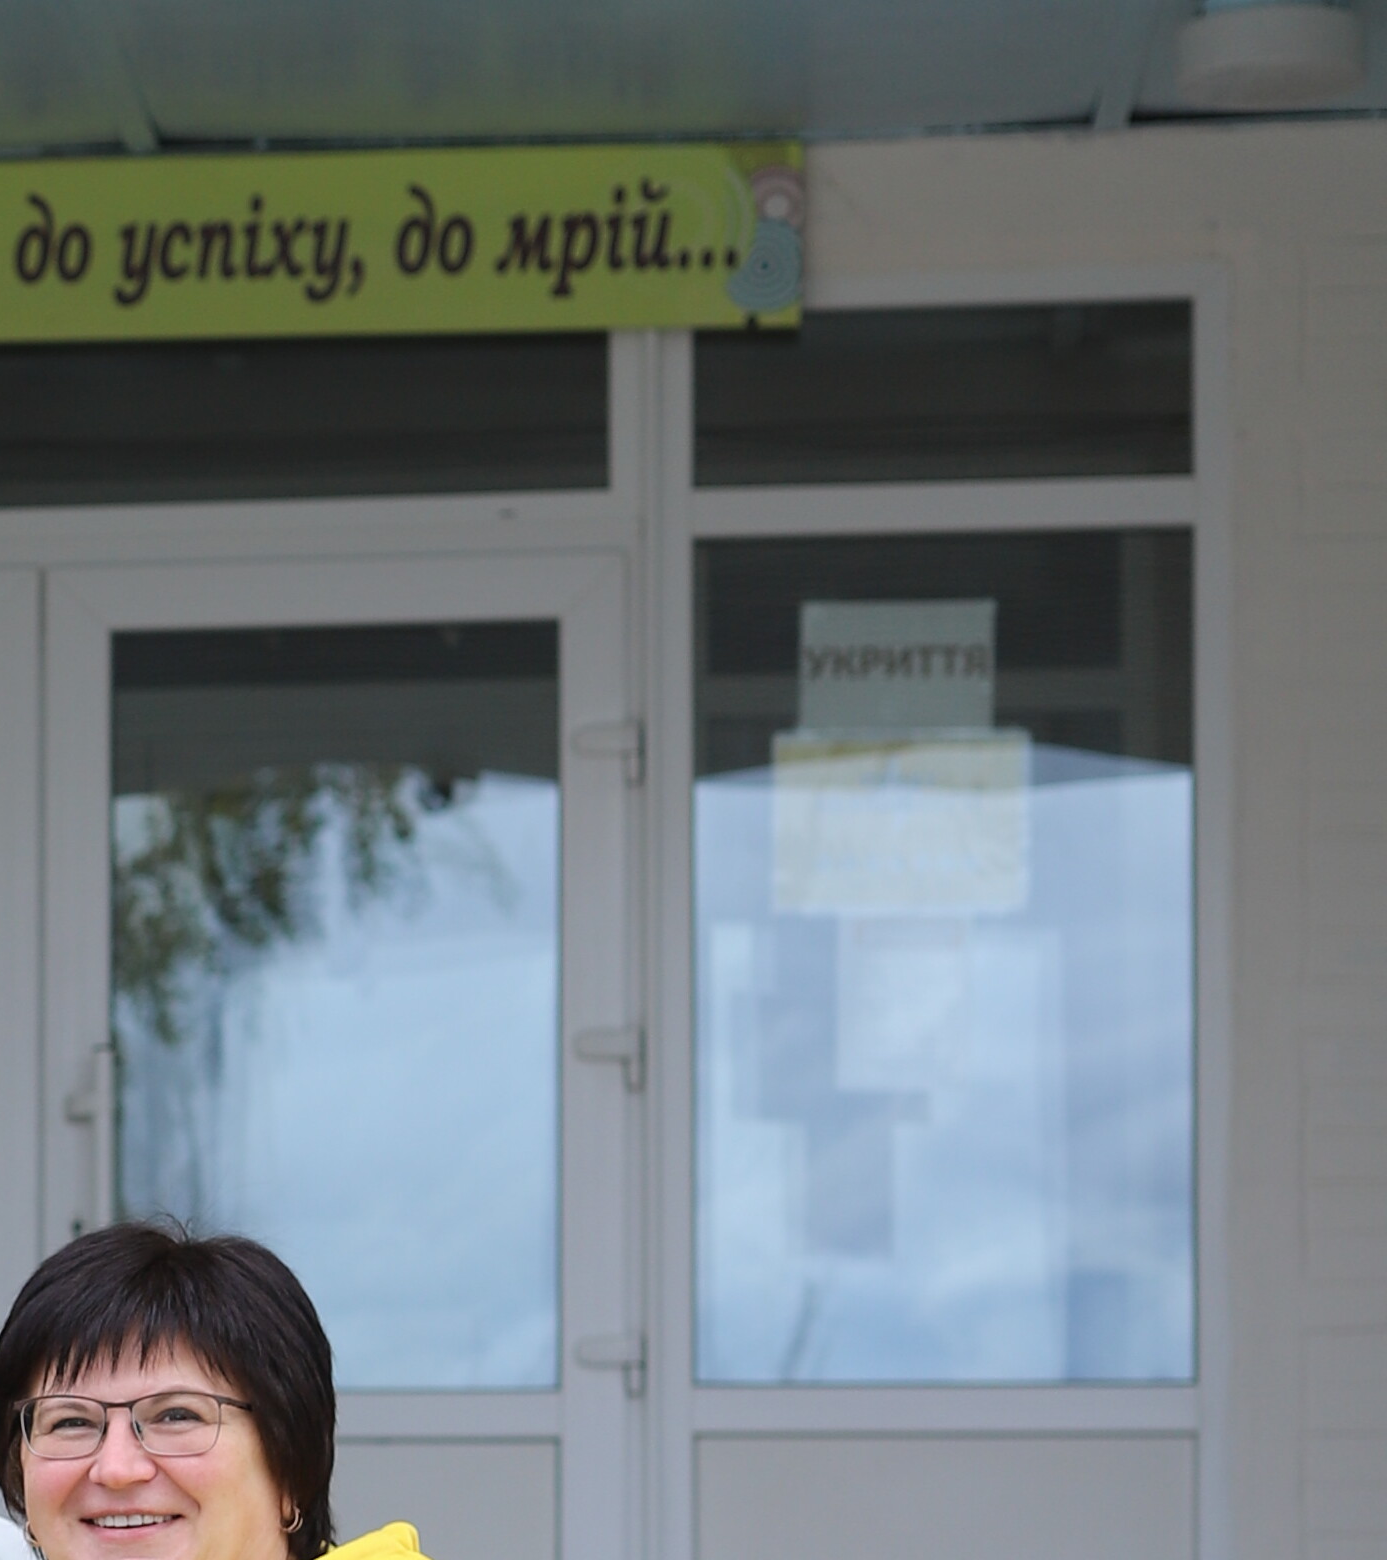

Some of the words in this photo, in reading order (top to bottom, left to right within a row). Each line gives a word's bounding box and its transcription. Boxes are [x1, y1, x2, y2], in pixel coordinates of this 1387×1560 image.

[15, 193, 93, 286] до
[113, 193, 367, 306] успіху,
[394, 183, 475, 276] до
[494, 178, 740, 298] мрій...
[804, 644, 989, 680] УКРИТТЯ
